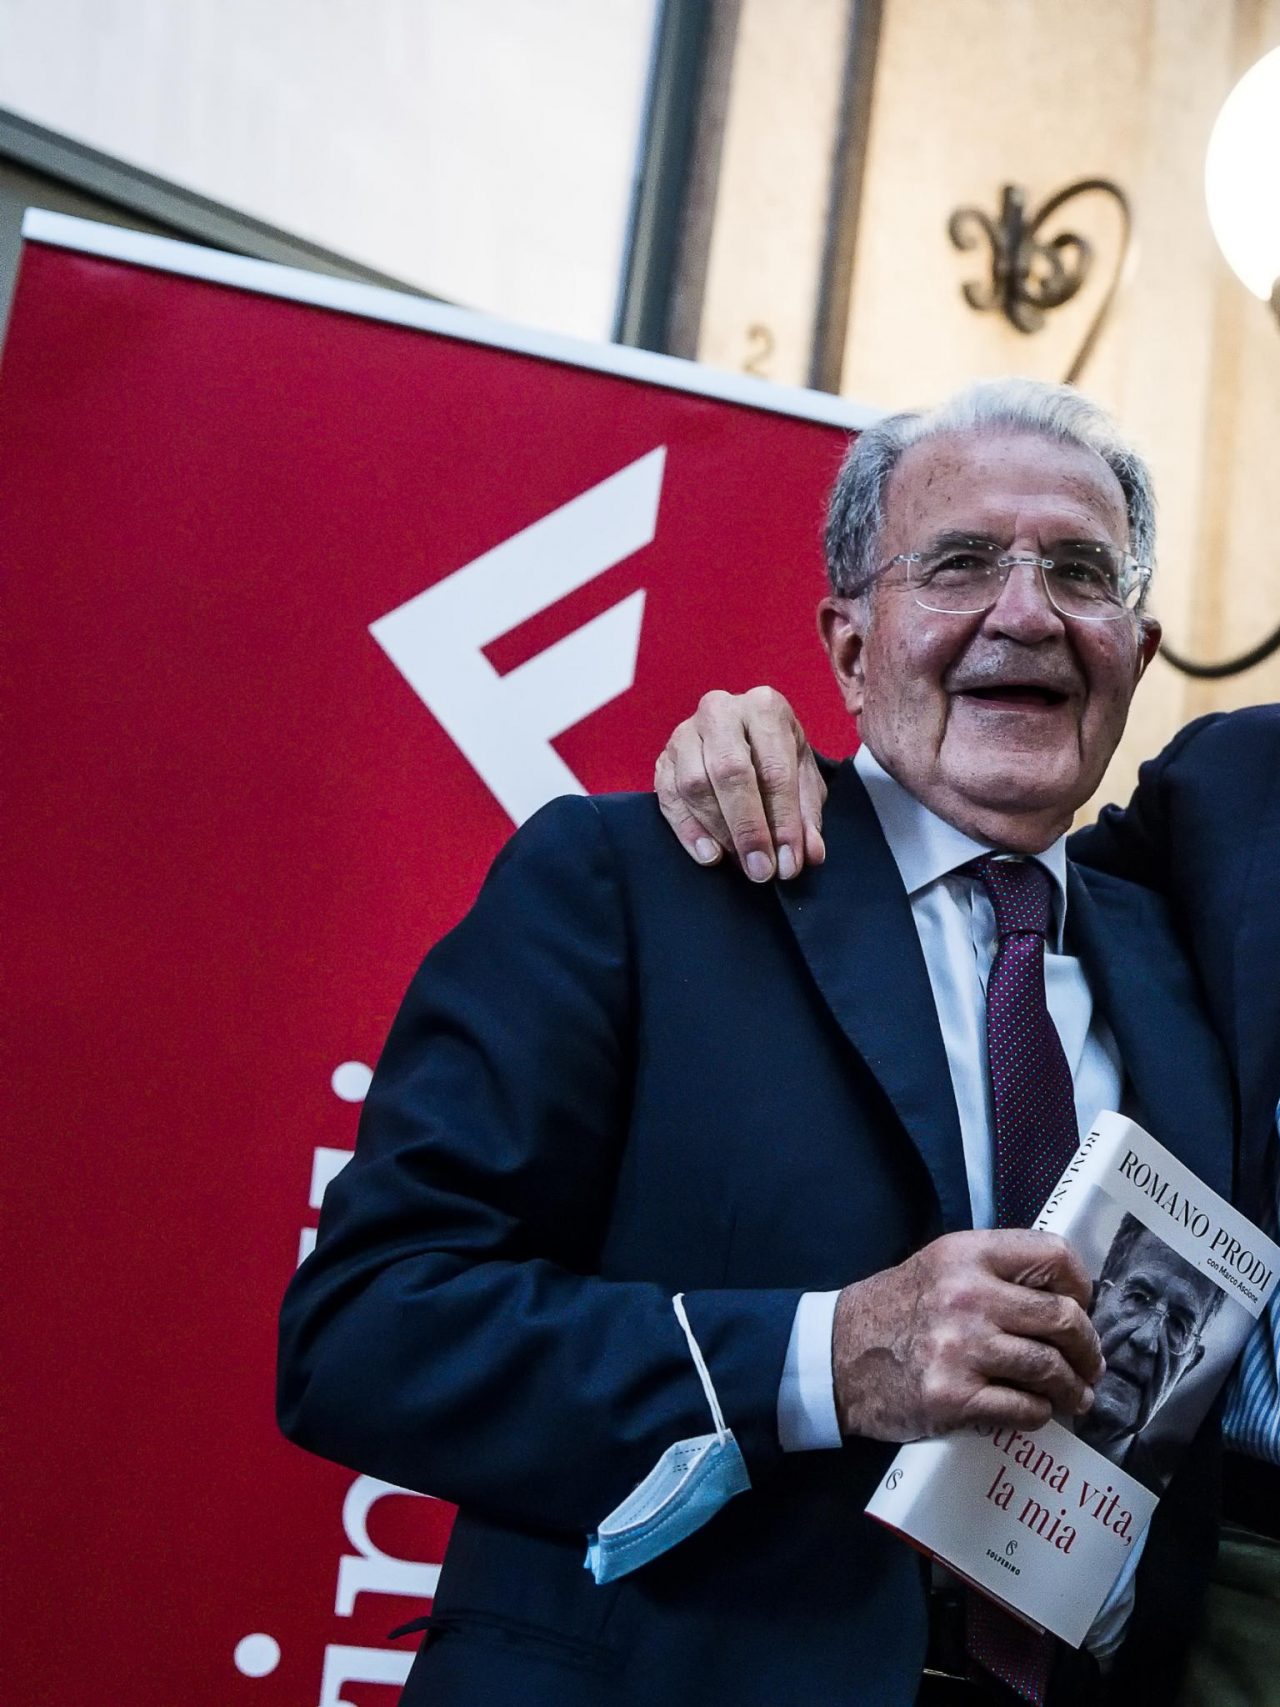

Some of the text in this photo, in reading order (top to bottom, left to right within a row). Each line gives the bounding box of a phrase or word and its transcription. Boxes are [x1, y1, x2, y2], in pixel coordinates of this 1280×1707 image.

[743, 324, 776, 380] 2
[1046, 1131, 1100, 1214] ROMANO
[1118, 1150, 1273, 1293] ROMANO PRODI
[1206, 1258, 1220, 1271] con
[1218, 1265, 1238, 1286] Marco
[985, 1465, 1077, 1555] la mia
[1079, 1480, 1133, 1547] vita,
[986, 1549, 1020, 1576] SOLFERINO
